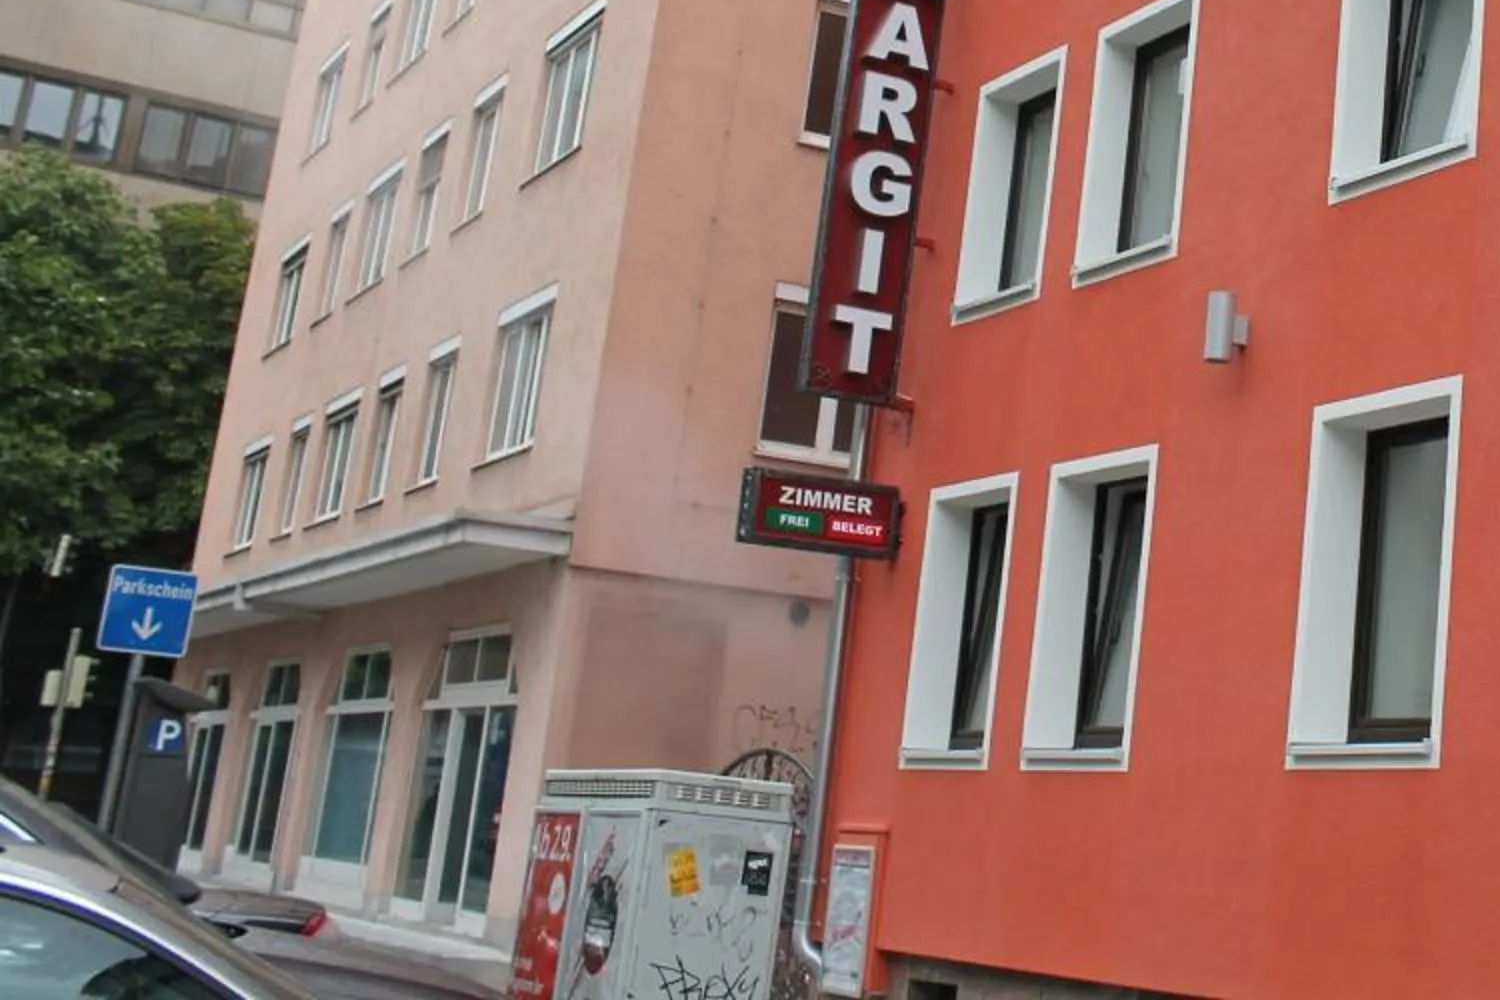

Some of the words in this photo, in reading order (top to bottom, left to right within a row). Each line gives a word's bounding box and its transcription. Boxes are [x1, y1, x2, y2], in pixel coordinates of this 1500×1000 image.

[778, 485, 873, 516] ZIMMER
[778, 512, 810, 529] FREI
[831, 519, 884, 538] BELEGT
[112, 574, 195, 601] Parkschein
[155, 718, 182, 752] P
